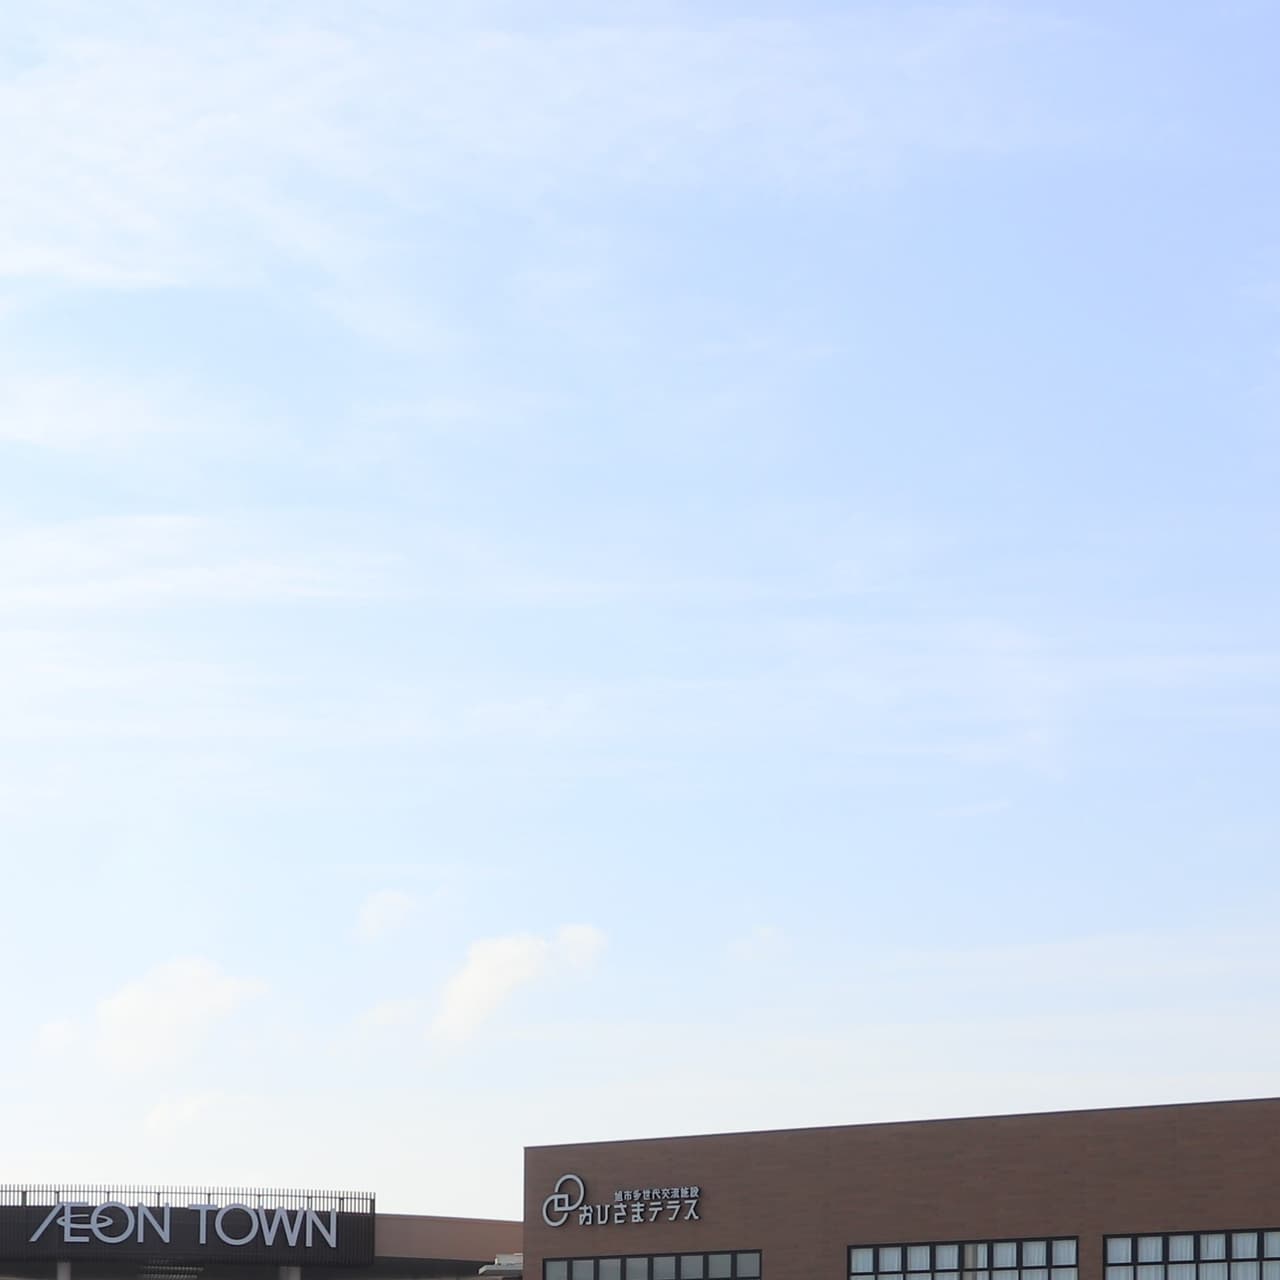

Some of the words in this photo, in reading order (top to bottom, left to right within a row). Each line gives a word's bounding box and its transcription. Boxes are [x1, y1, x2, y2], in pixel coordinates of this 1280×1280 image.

[188, 1203, 337, 1248] TOWN
[578, 1199, 699, 1225] おひさまテラス
